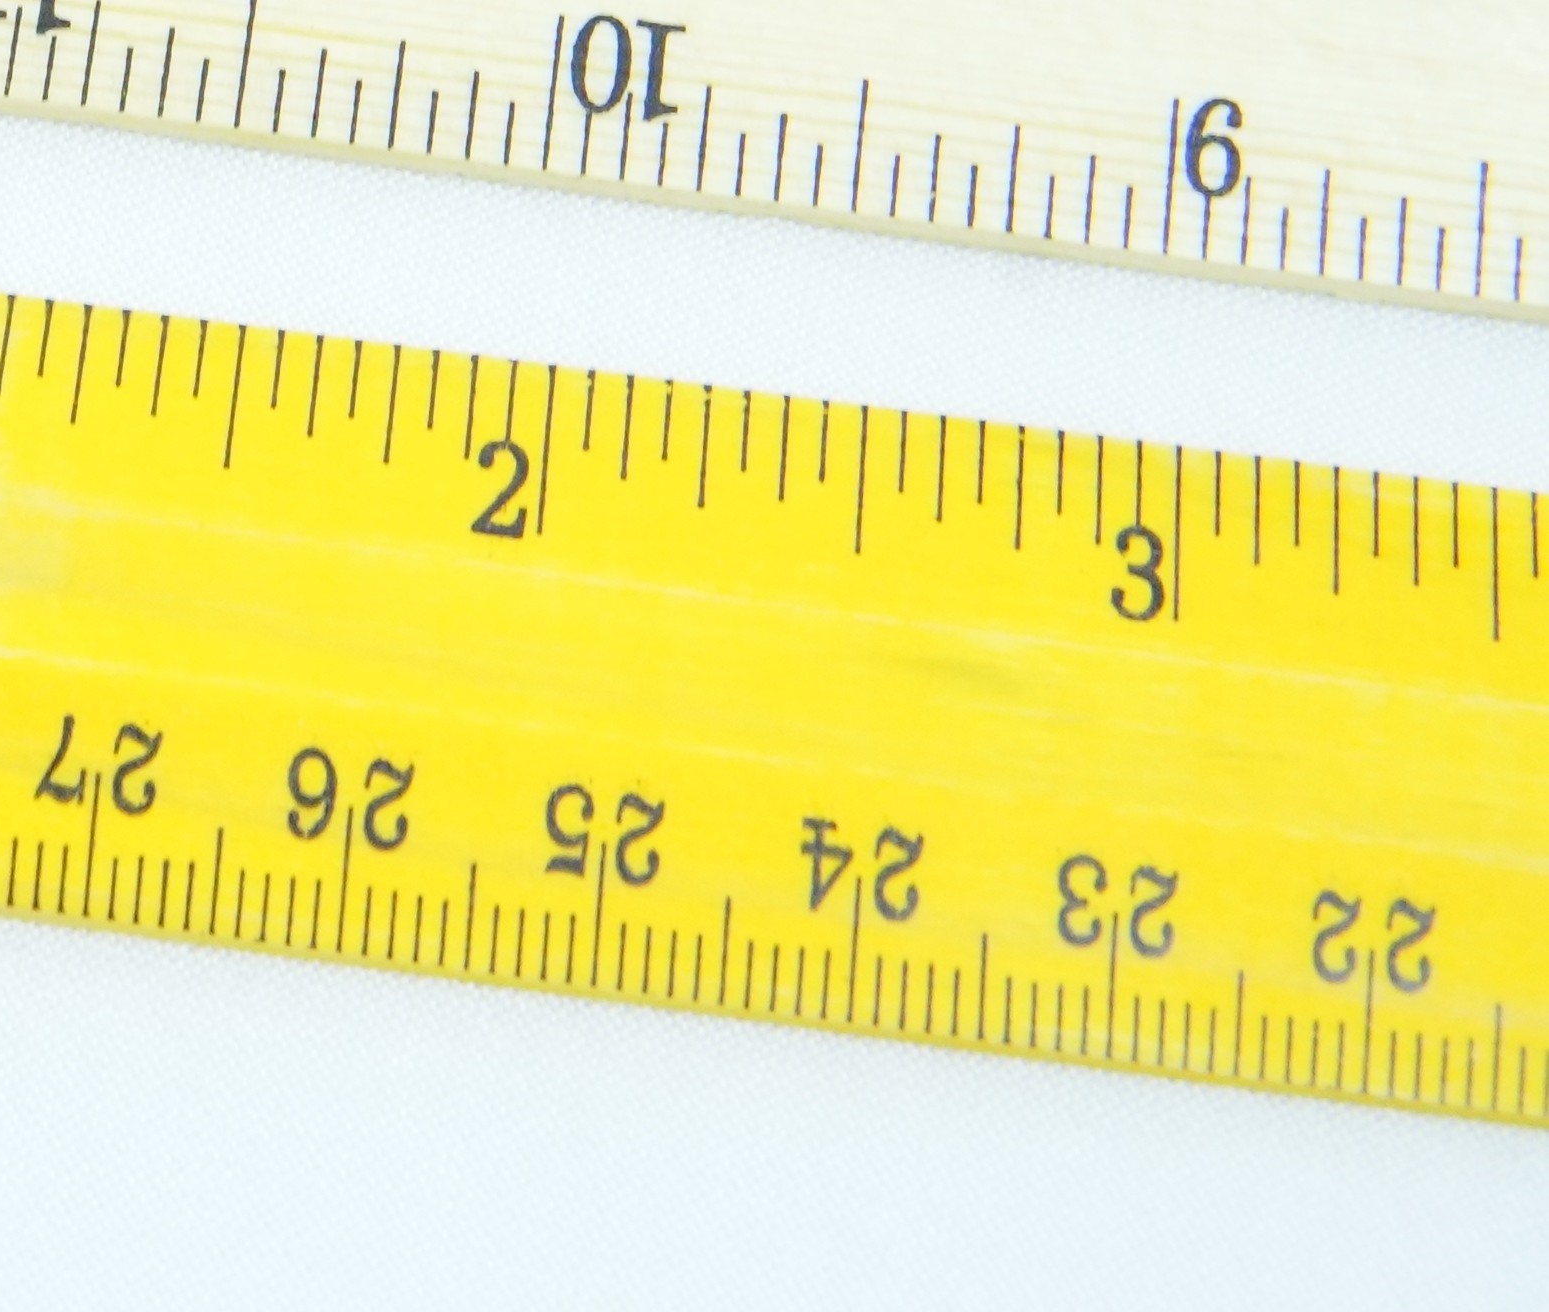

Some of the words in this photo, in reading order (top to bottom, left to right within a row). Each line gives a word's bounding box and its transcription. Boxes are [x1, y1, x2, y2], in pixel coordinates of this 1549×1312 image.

[569, 14, 685, 122] 10
[471, 442, 531, 541] 2
[1111, 528, 1166, 623] 3
[36, 715, 164, 816] 27
[286, 746, 415, 851] 26
[544, 784, 667, 886] 25
[800, 816, 924, 921] 24
[1058, 855, 1180, 959] 23
[1311, 889, 1438, 992] 22
